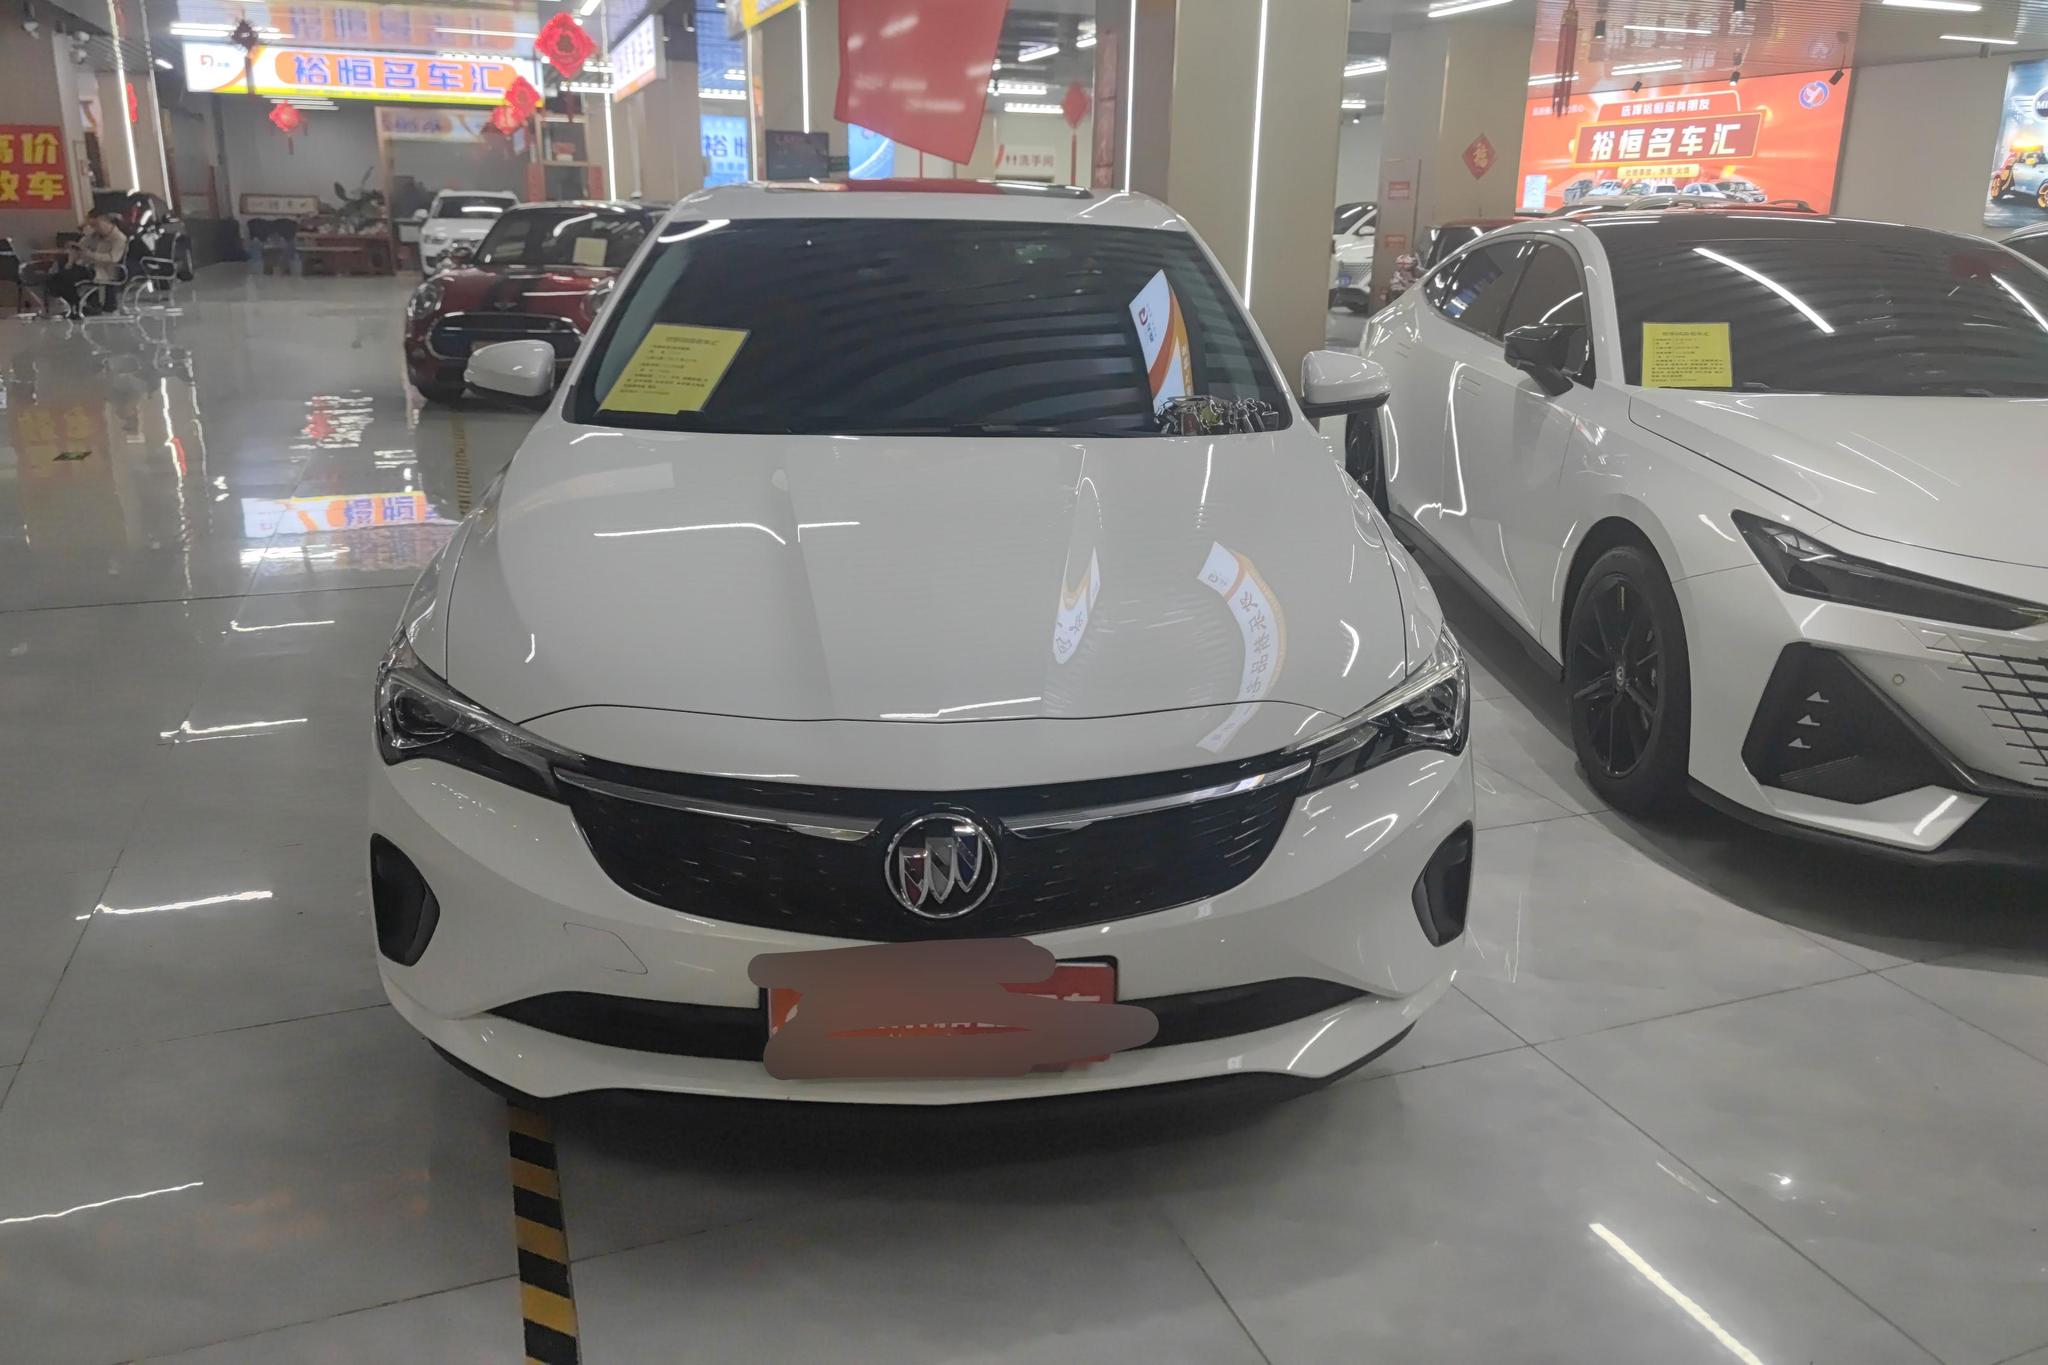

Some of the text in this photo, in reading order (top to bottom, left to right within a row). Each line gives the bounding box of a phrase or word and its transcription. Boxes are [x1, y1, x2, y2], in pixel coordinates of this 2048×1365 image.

[294, 55, 504, 94] 裕恒名车汇
[1590, 123, 1741, 161] 裕恒名车汇
